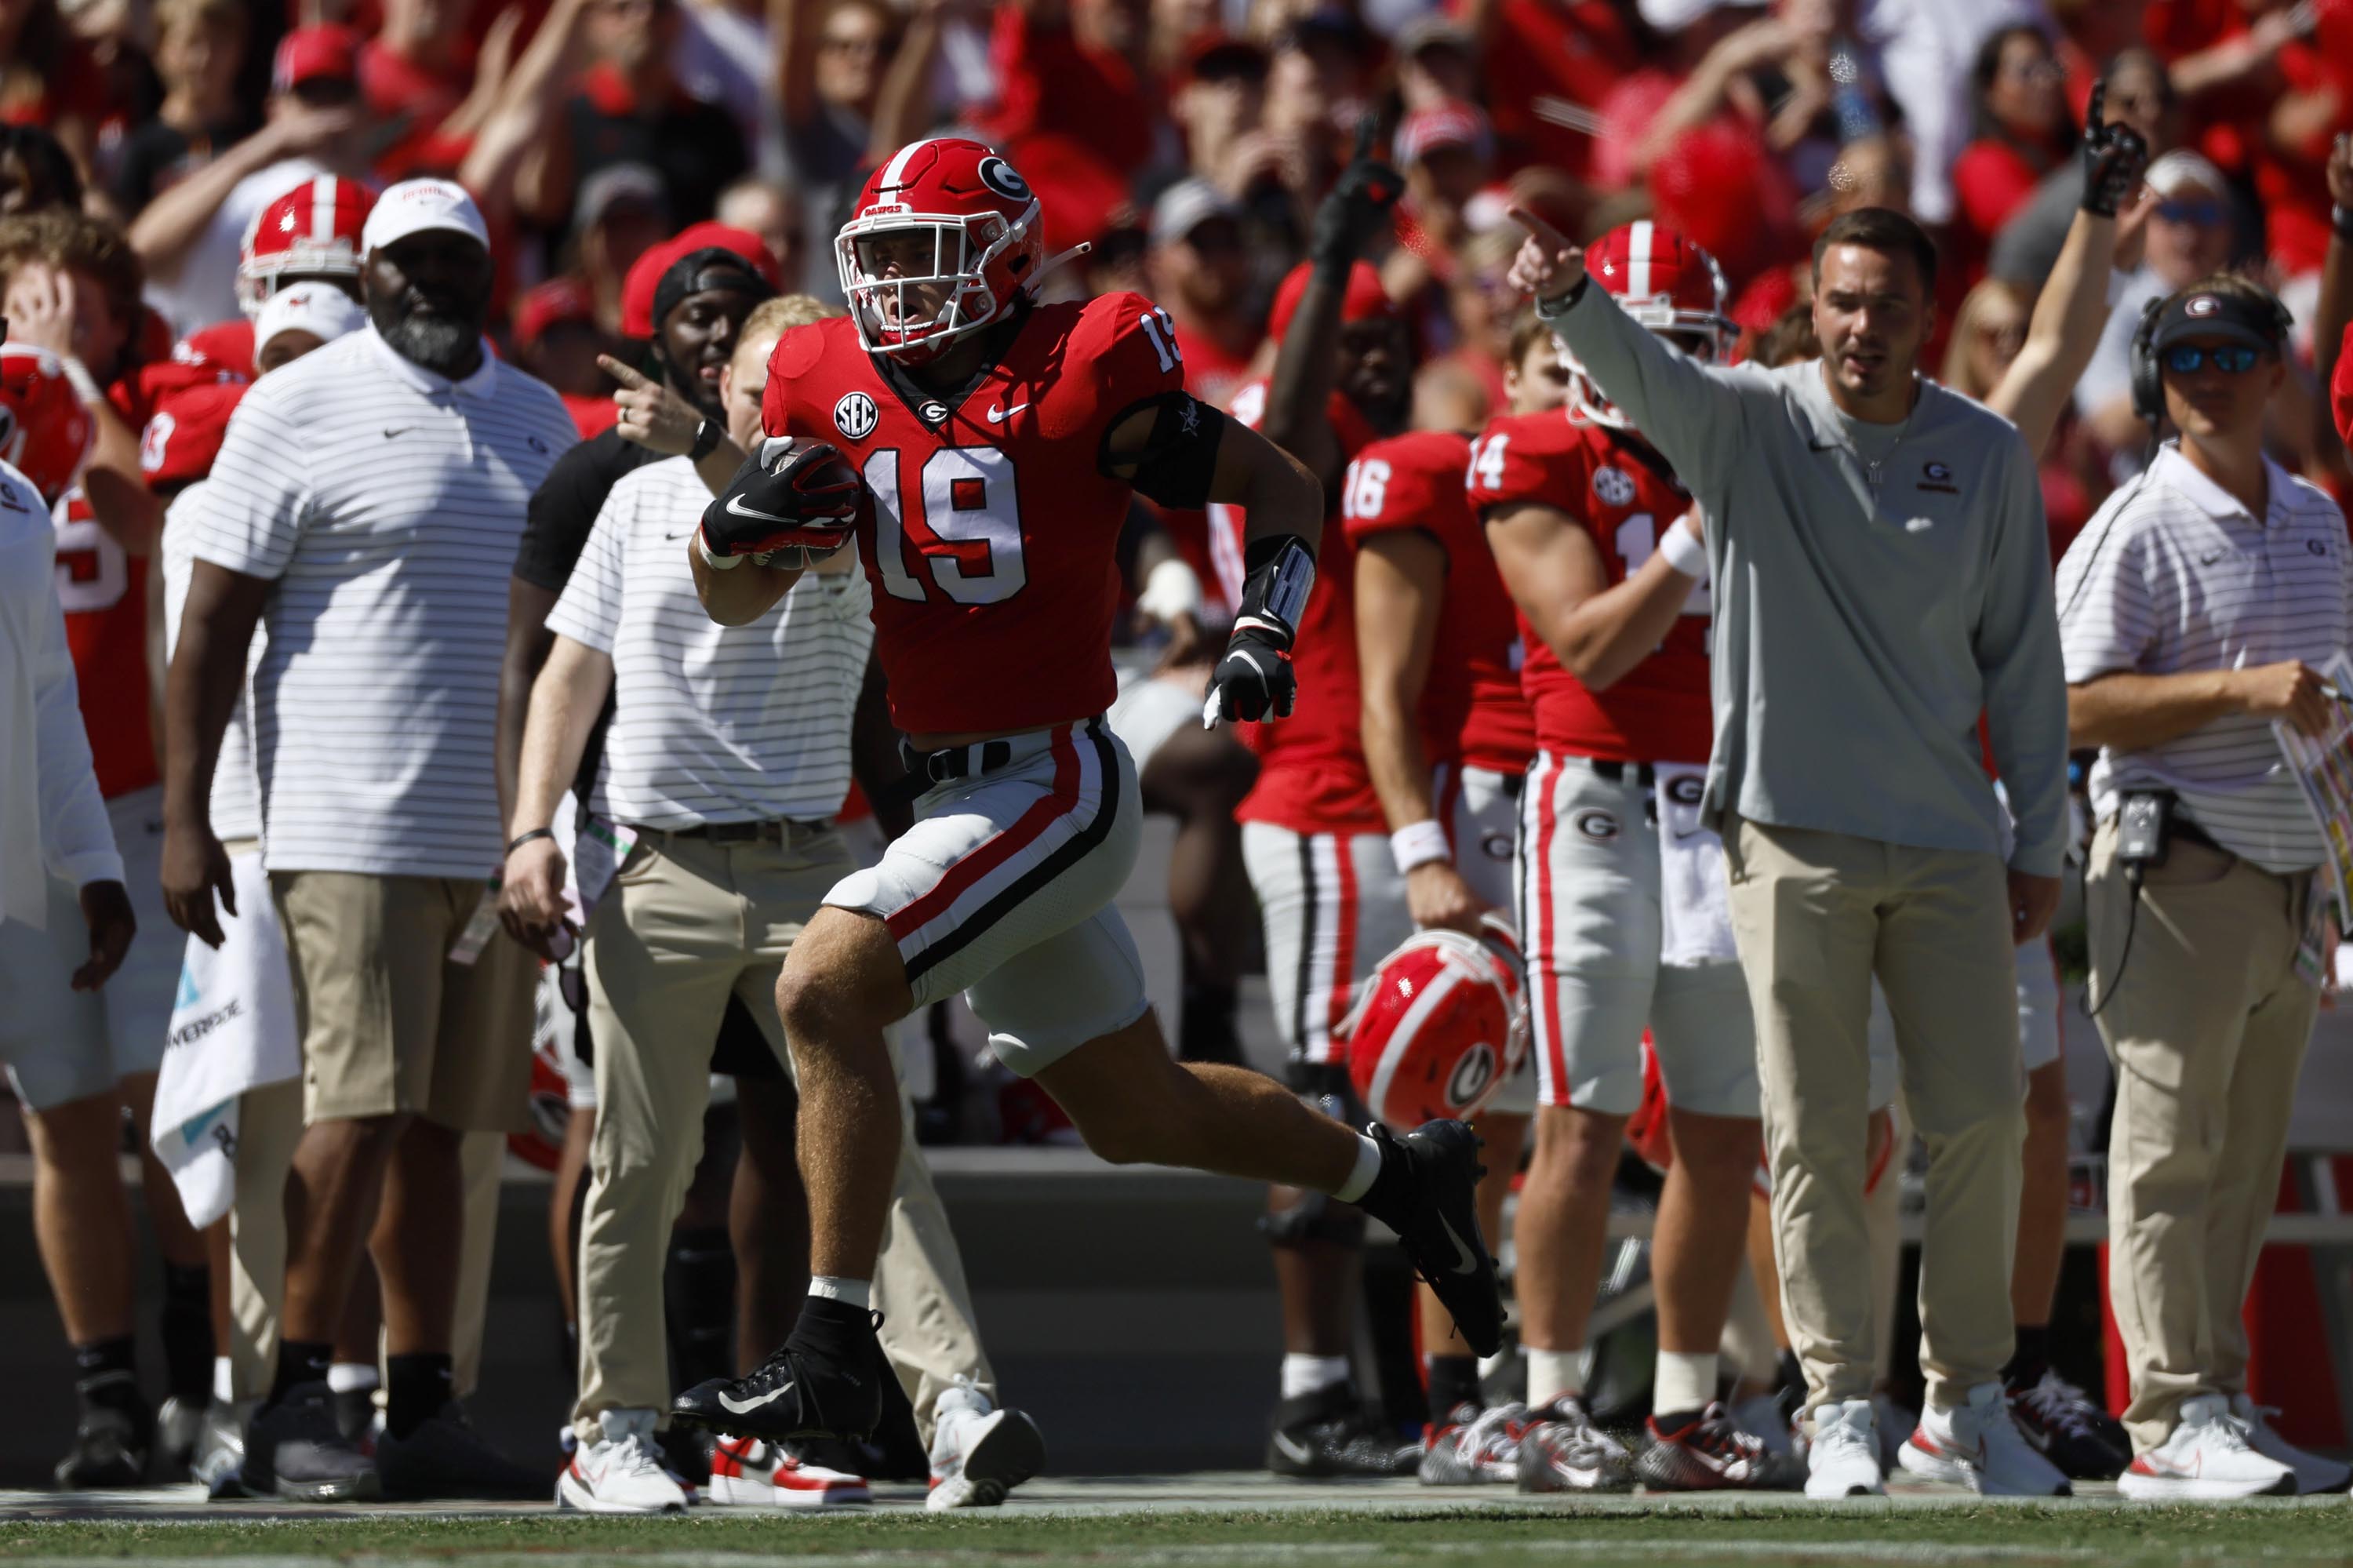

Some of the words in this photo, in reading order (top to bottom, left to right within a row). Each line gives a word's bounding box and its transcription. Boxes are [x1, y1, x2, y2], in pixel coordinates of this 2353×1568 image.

[864, 205, 903, 216] DAWGS
[837, 395, 873, 435] SEC
[1342, 457, 1392, 520] 16
[1464, 432, 1510, 489] 14
[861, 446, 1027, 606] 19
